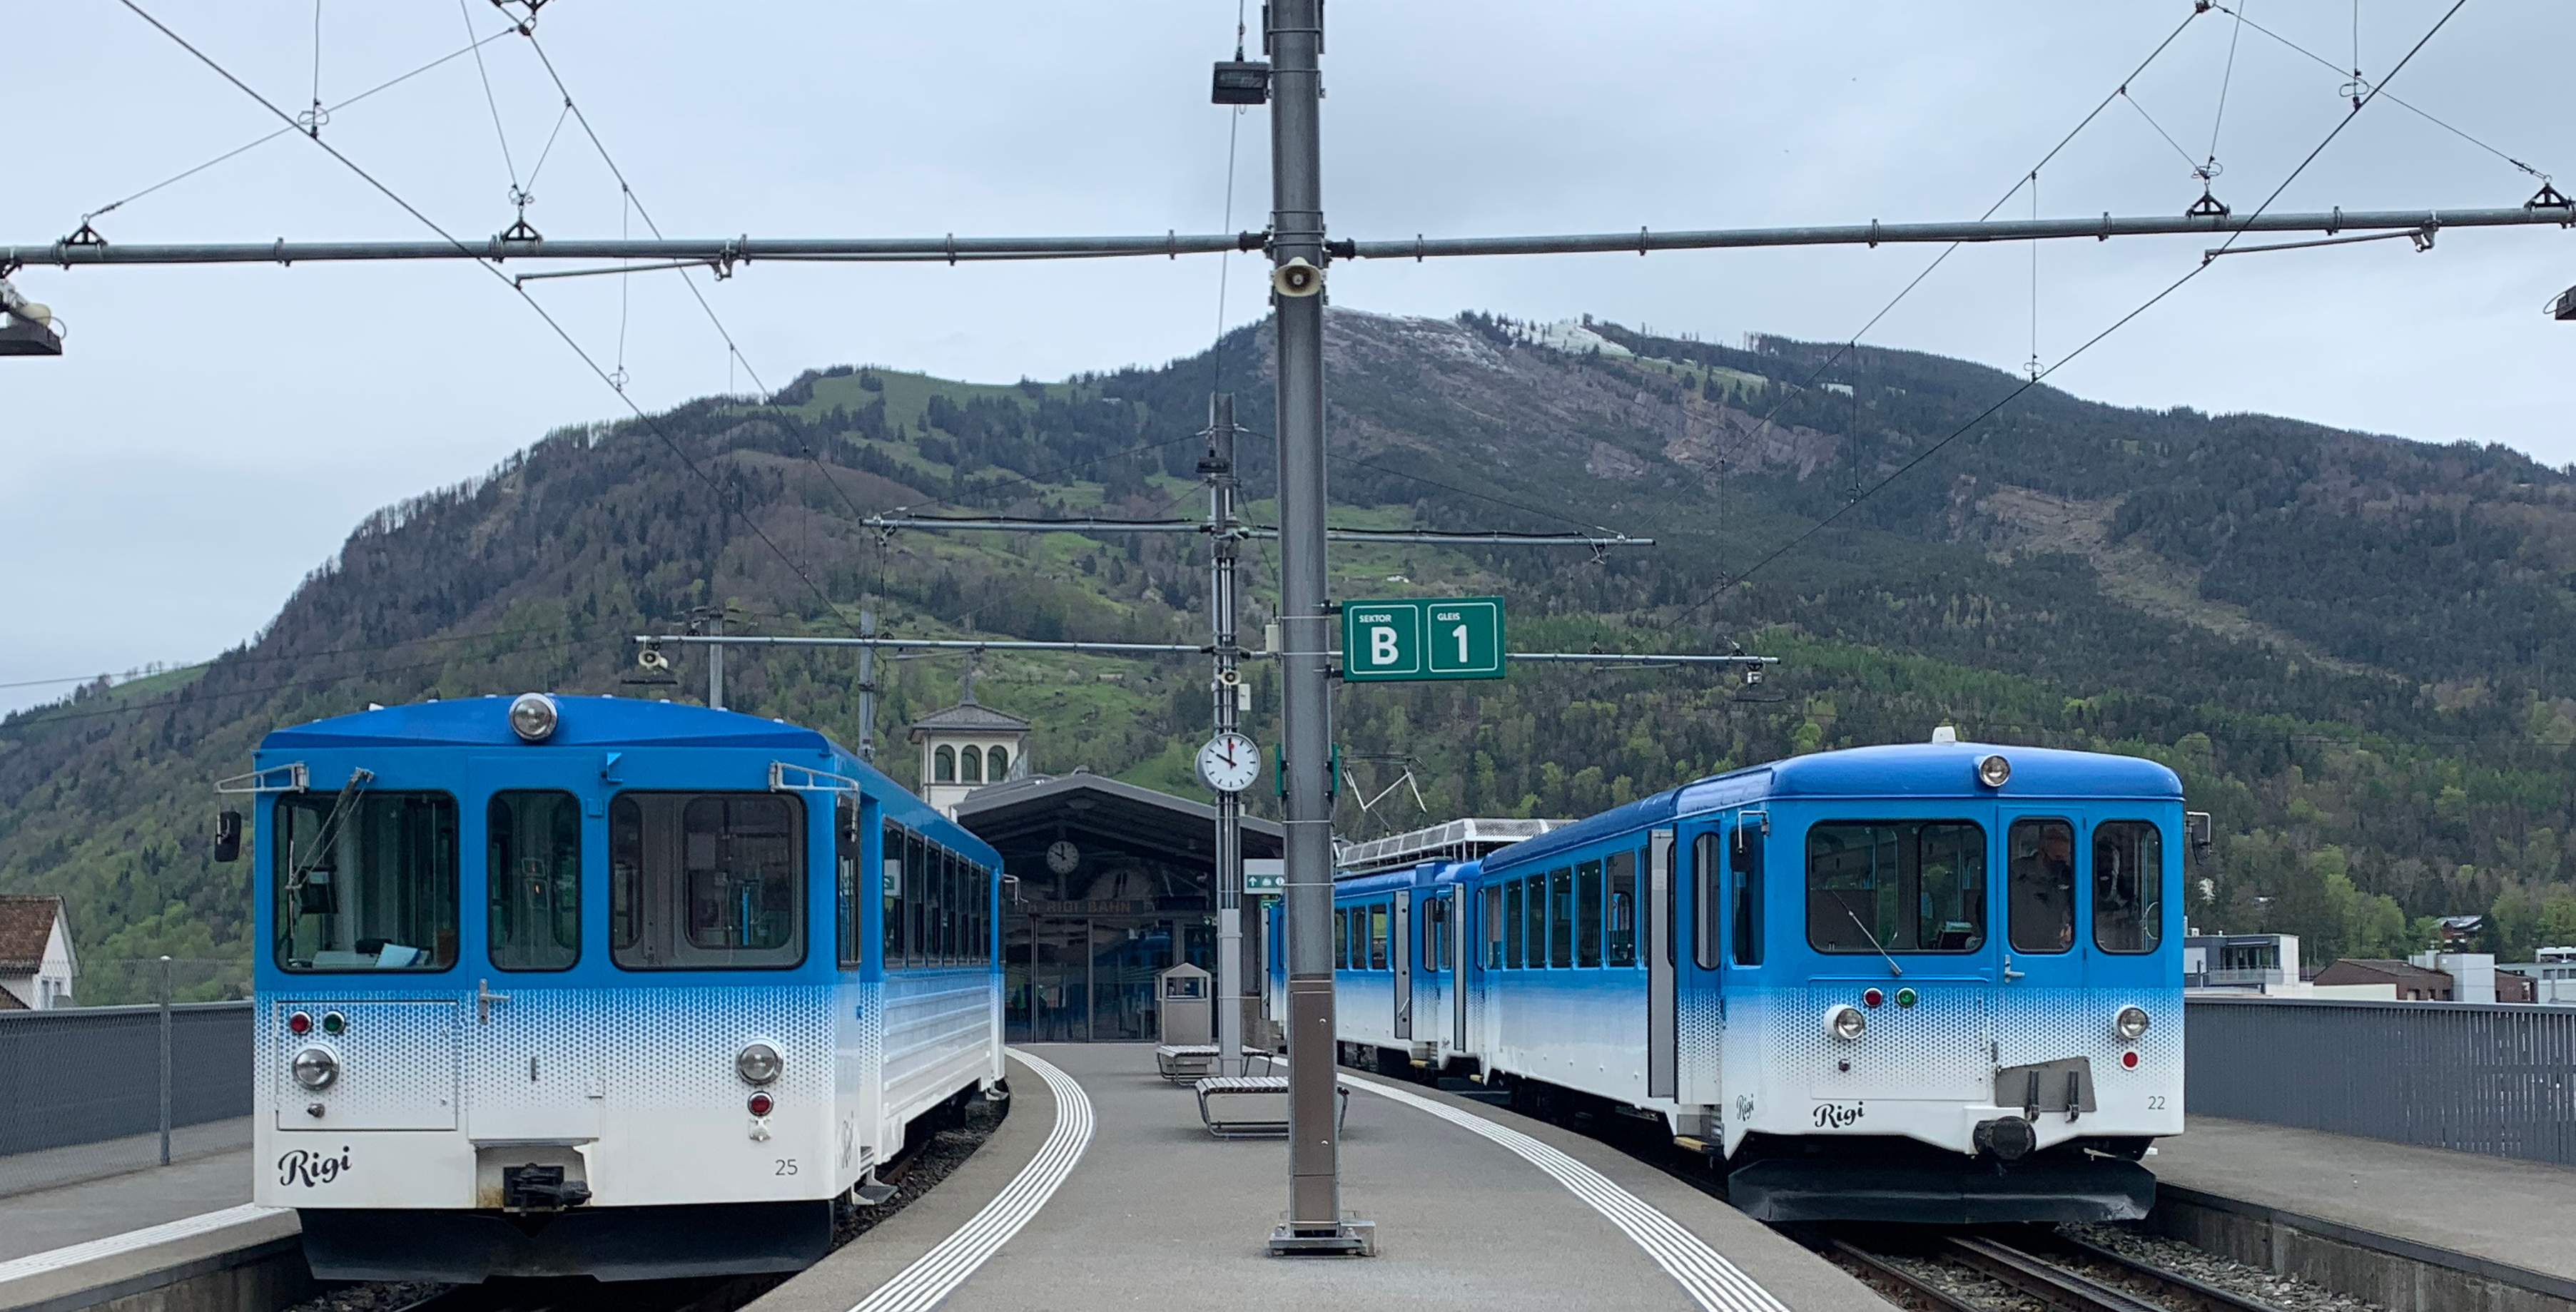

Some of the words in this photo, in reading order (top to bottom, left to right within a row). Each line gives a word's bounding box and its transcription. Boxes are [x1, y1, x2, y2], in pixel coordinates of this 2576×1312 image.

[1359, 614, 1392, 623] SEKTOR
[1436, 612, 1461, 621] GLEIS
[1371, 626, 1399, 665] B
[1452, 624, 1468, 663] 1
[1737, 1094, 1754, 1122] Rigi
[1813, 1101, 1865, 1129] Rigi
[2148, 1095, 2166, 1110] 22
[278, 1145, 353, 1188] Rigi
[775, 1159, 798, 1176] 25
